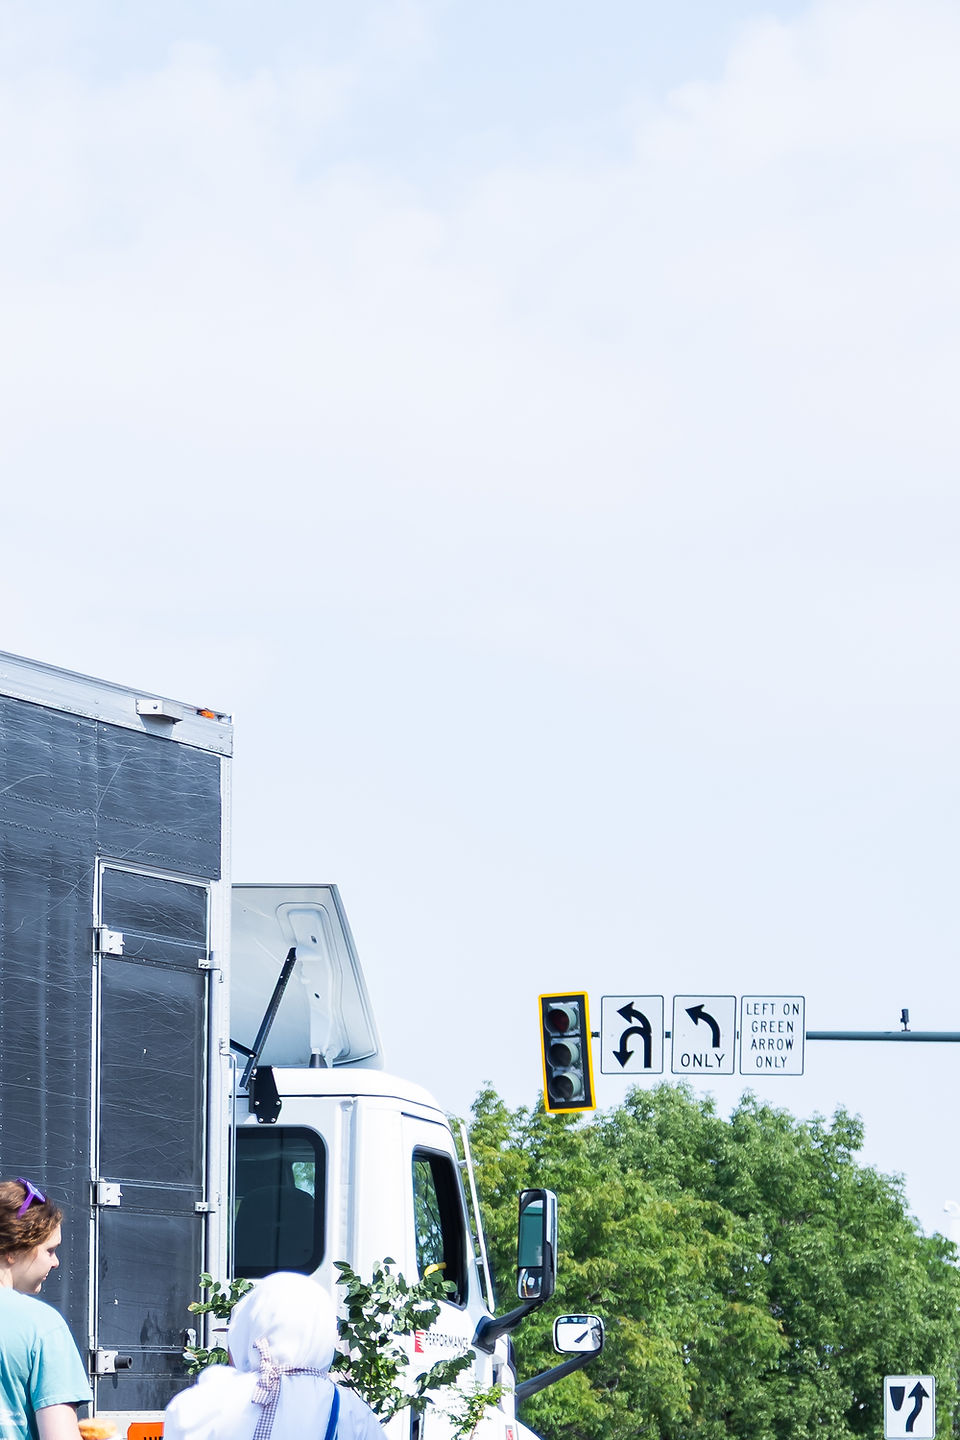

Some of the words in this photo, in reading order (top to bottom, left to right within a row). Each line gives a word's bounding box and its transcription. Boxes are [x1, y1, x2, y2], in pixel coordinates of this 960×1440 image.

[746, 1003, 776, 1016] LEFT
[783, 1003, 800, 1016] ON
[751, 1020, 794, 1033] GREEN
[751, 1038, 794, 1051] ARROW
[681, 1053, 726, 1068] ONLY
[755, 1055, 787, 1069] ONLY
